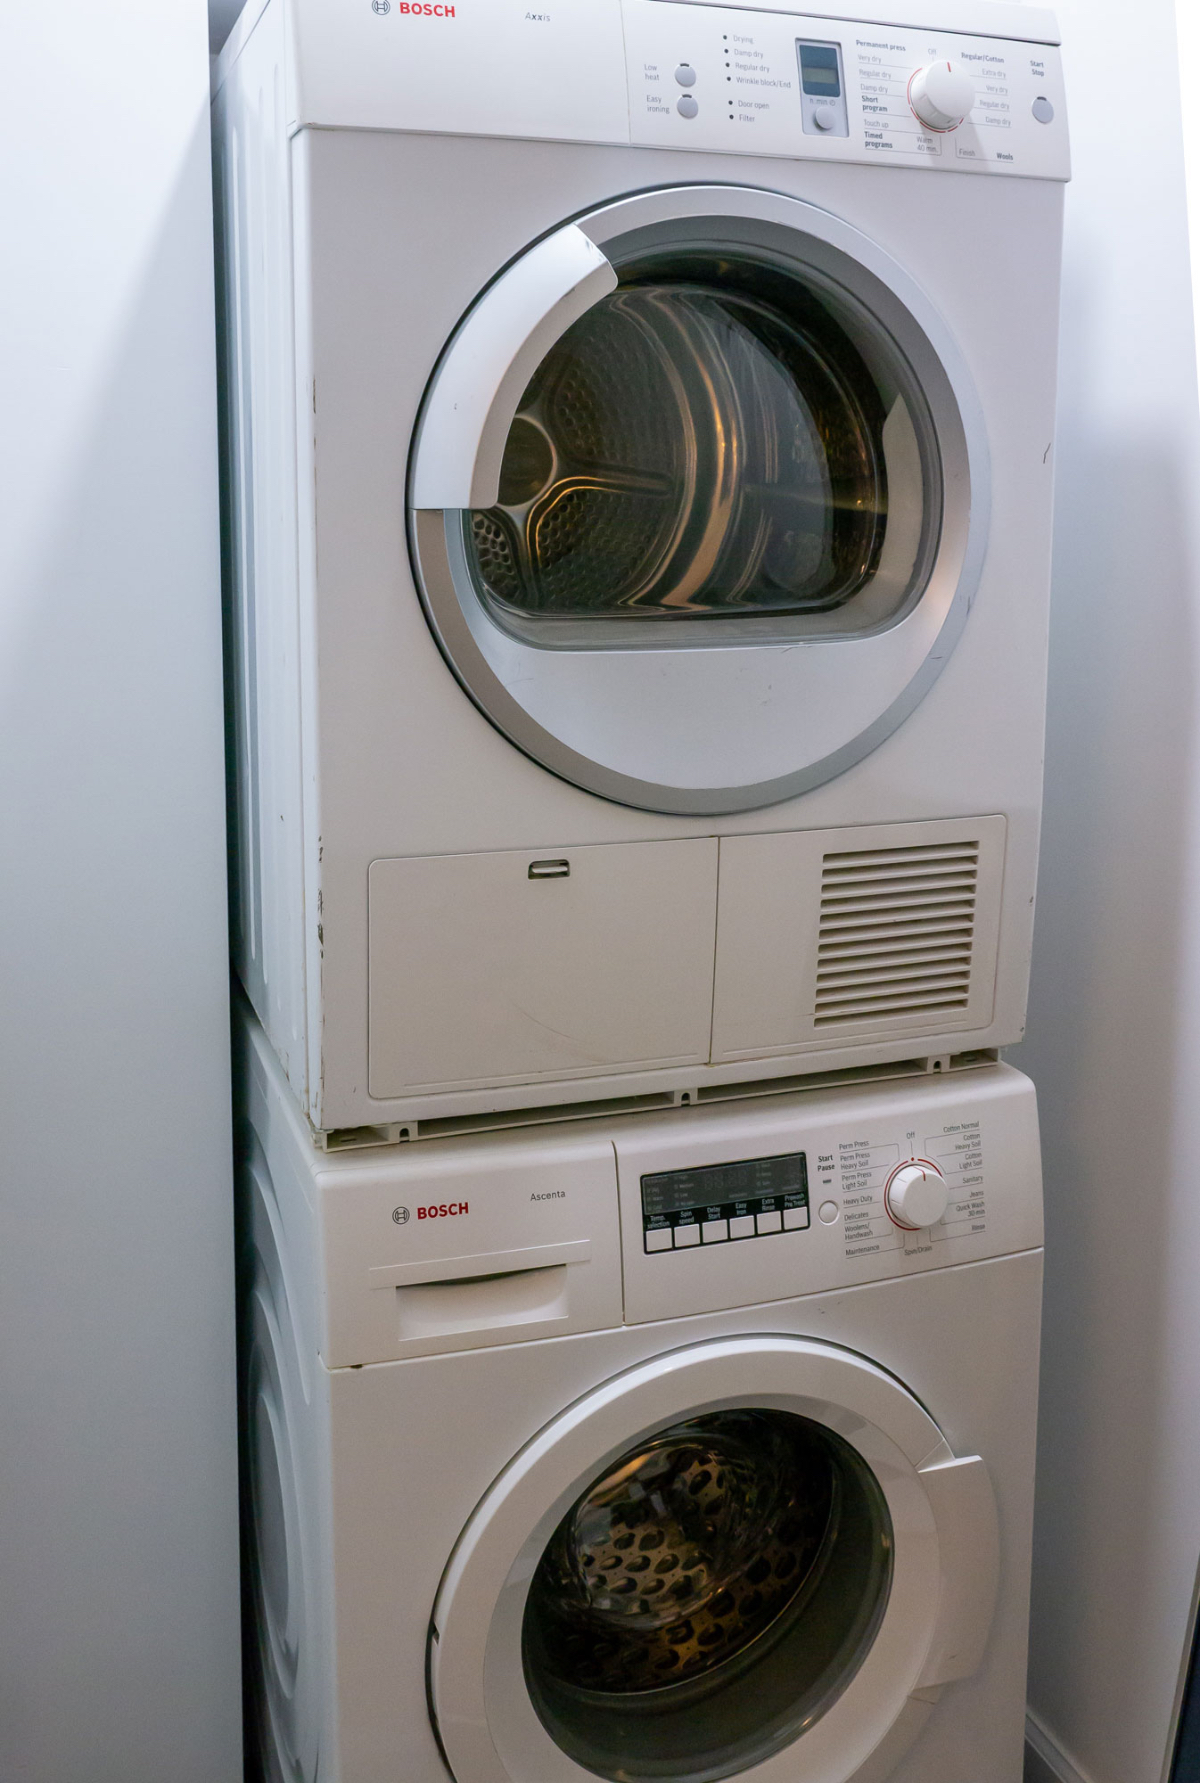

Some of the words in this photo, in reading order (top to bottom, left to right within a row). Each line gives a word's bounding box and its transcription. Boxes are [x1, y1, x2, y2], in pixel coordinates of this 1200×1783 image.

[400, 2, 455, 17] BOSCH
[525, 12, 550, 22] Axxis
[733, 35, 754, 45] Drying
[856, 40, 888, 50] Permanent
[889, 43, 906, 52] press
[734, 49, 752, 58] Damp
[753, 51, 764, 59] dry
[857, 54, 870, 62] Very
[872, 55, 882, 64] dry
[735, 62, 758, 72] Regular
[760, 65, 770, 73] dry
[1030, 60, 1044, 68] Start
[645, 73, 659, 81] heat
[859, 68, 881, 78] Regular
[882, 70, 891, 79] dry
[1031, 69, 1044, 77] Stop
[736, 77, 759, 85] Wrinkle
[760, 78, 791, 88] block/End
[860, 83, 877, 92] Damp
[878, 85, 888, 94] dry
[646, 95, 662, 104] Easy
[861, 95, 878, 103] Short
[647, 105, 670, 114] ironing
[738, 100, 754, 108] Door
[754, 101, 770, 110] open
[862, 104, 888, 113] program
[739, 114, 755, 122] Filter
[864, 119, 880, 127] Touch
[864, 131, 883, 139] Timed
[864, 140, 893, 149] programs
[959, 148, 975, 157] Finish
[996, 152, 1014, 160] Wools
[943, 1125, 961, 1133] Cotton
[961, 1121, 979, 1129] Normal
[906, 1131, 915, 1139] Off
[963, 1133, 981, 1141] Cotton
[839, 1142, 853, 1151] Perm
[854, 1140, 869, 1148] Press
[955, 1142, 971, 1151] Heavy
[971, 1140, 981, 1148] Soil
[818, 1154, 833, 1163] Start
[840, 1154, 854, 1162] Perm
[855, 1152, 870, 1160] Press
[965, 1152, 982, 1160] Cotton
[817, 1164, 835, 1172] Pause
[840, 1162, 857, 1170] Heavy
[959, 1161, 972, 1170] Light
[973, 1159, 983, 1167] Soil
[841, 1173, 856, 1182] Perm
[857, 1171, 872, 1179] Press
[962, 1175, 984, 1184] Sanitary
[842, 1182, 856, 1191] Light
[856, 1180, 868, 1188] Soil
[530, 1190, 566, 1202] Ascenta
[969, 1190, 984, 1198] Jeans
[843, 1197, 860, 1206] Heavy
[860, 1195, 873, 1204] Duty
[706, 1206, 721, 1214] Delay
[735, 1202, 747, 1210] Easy
[956, 1203, 971, 1212] Quick
[417, 1202, 469, 1220] BOSCH
[844, 1211, 869, 1221] Delicates
[647, 1221, 670, 1229] selection
[679, 1217, 694, 1225] speed
[845, 1230, 873, 1240] Handwash
[845, 1244, 880, 1256] Maintenance
